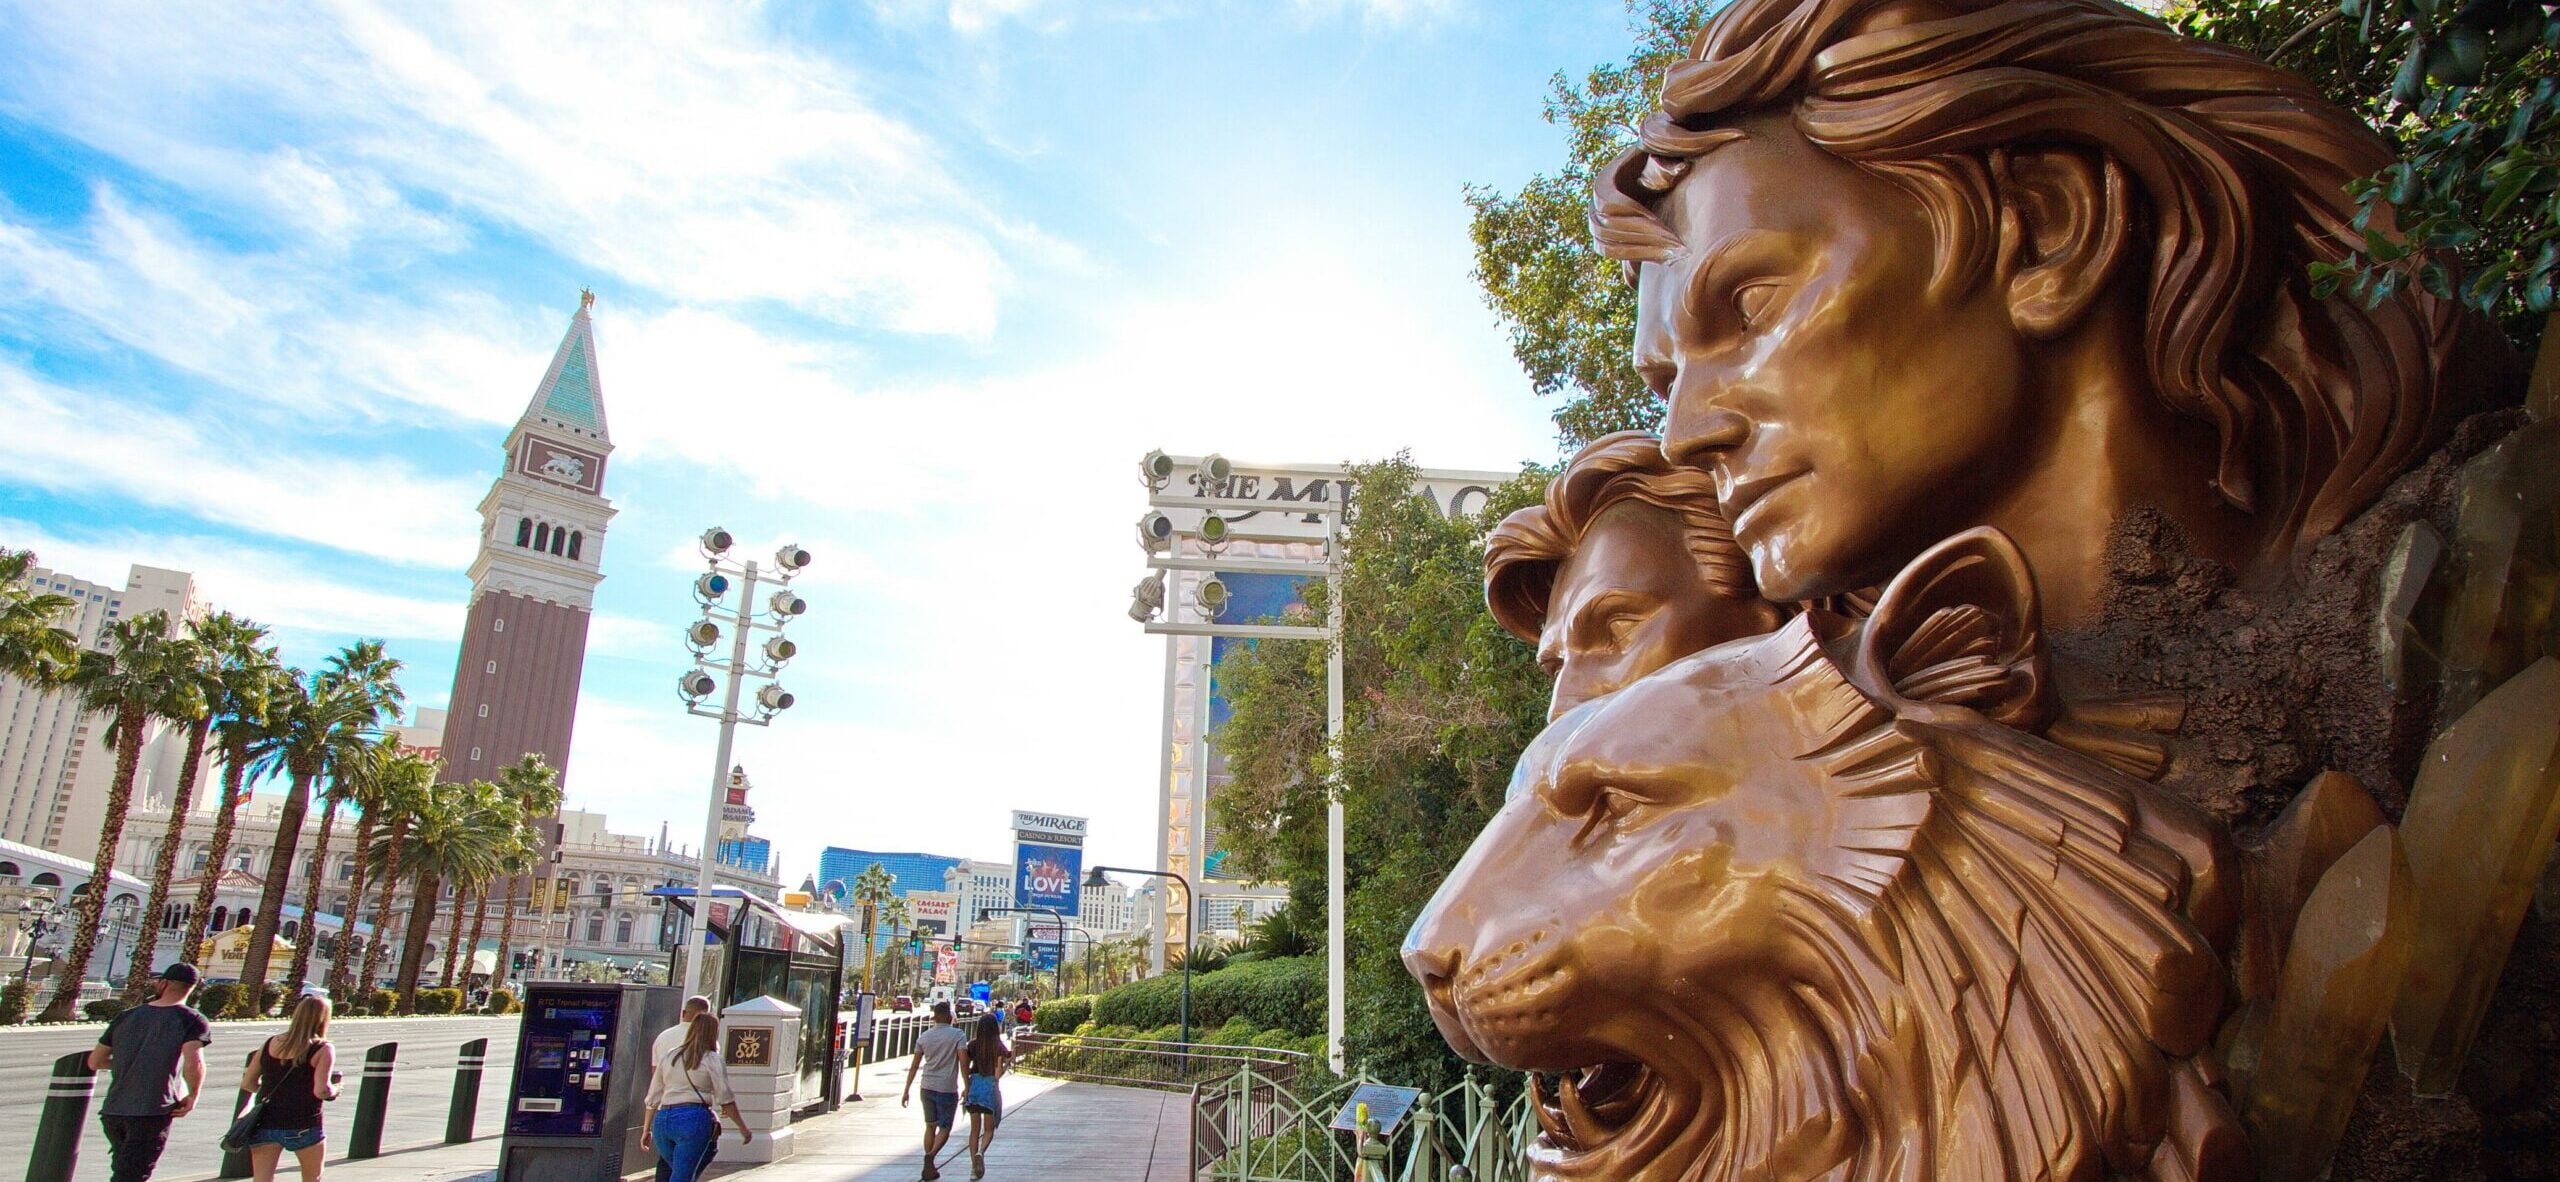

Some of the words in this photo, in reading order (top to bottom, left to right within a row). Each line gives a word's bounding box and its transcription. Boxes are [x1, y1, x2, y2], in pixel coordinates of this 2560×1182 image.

[1023, 815, 1085, 831] MIRAGE
[1019, 831, 1046, 840] CASINO
[1055, 836, 1081, 845] RESORT
[1024, 875, 1071, 894] LOVE
[917, 900, 950, 908] CAESARS
[917, 907, 948, 915] PALACE
[538, 998, 555, 1006] RTC
